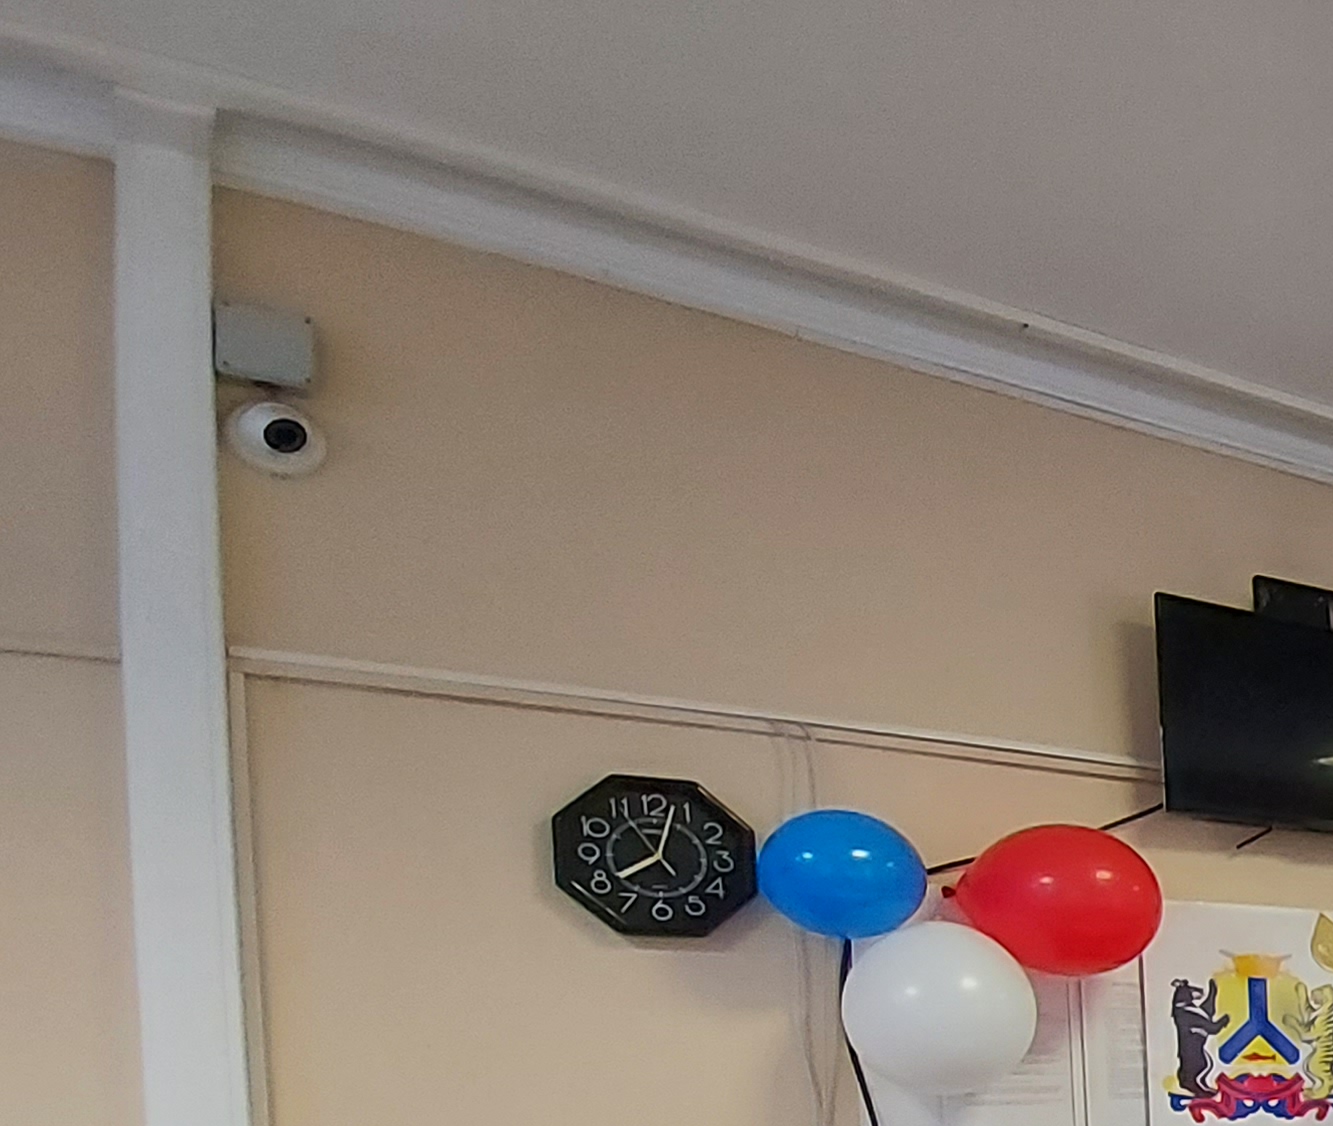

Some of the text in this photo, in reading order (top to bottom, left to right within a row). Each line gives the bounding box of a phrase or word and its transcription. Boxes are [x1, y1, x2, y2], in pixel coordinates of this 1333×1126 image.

[609, 796, 629, 818] 11
[640, 793, 668, 817] 12
[682, 801, 692, 824] 1
[580, 815, 611, 838] 10
[702, 822, 724, 845] 2
[577, 842, 601, 866] 9
[712, 850, 735, 873] 3
[590, 869, 612, 894] 8
[704, 876, 726, 900] 4
[617, 891, 639, 914] 7
[651, 899, 674, 921] 6
[684, 896, 707, 917] 5
